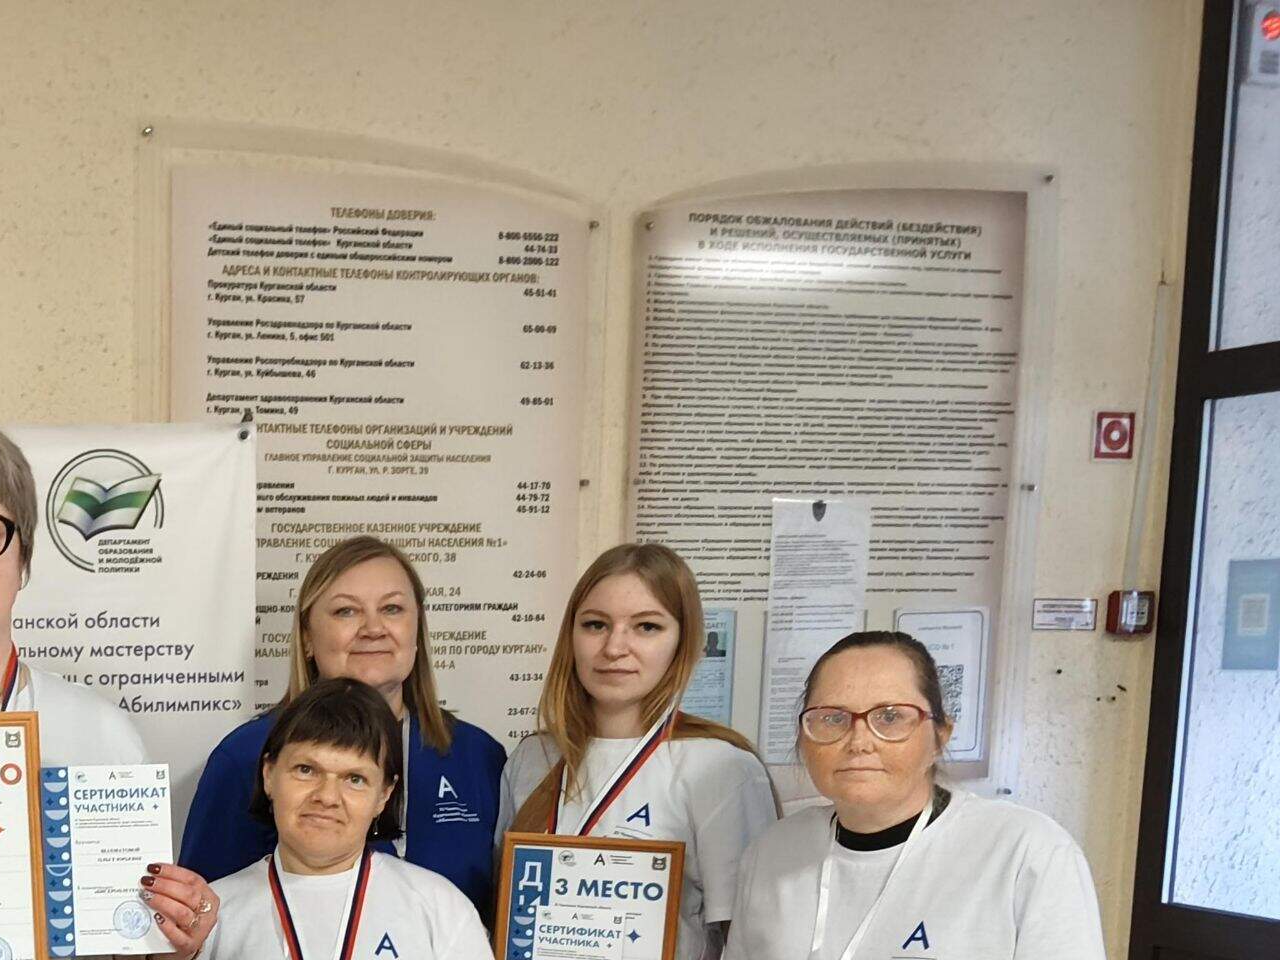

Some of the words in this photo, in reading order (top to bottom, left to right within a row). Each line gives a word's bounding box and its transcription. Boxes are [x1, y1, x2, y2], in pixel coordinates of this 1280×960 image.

[331, 207, 385, 218] ТЕЛЕФОНЫ
[387, 210, 436, 220] ДОВЕРИЯ:
[689, 213, 743, 224] ПОРЯДОК
[747, 217, 832, 227] ОБЖАЛОВАНИЯ
[836, 218, 893, 230] ДЕЙСТВИЙ
[897, 221, 982, 237] (БЕЗДЕЙСТВИЯ)
[710, 228, 718, 236] И
[721, 227, 779, 239] РЕШЕНИЙ,
[782, 230, 889, 244] ОСУЩЕСТВЛЯЕМЫХ
[892, 234, 961, 248] (ПРИНЯТЫХ)
[336, 239, 379, 248] Курганской
[382, 241, 413, 249] области
[208, 247, 240, 256] Детский
[242, 249, 274, 258] телефон
[709, 242, 737, 250] ХОДЕ
[742, 242, 818, 253] ИСПОЛНЕНИЯ
[820, 245, 927, 258] ГОСУДАРСТВЕННОЙ
[930, 250, 971, 260] УСЛУГИ
[222, 264, 260, 275] АДРЕСА
[263, 265, 270, 275] И
[272, 266, 338, 278] КОНТАКТНЫЕ
[340, 268, 393, 279] ТЕЛЕФОНЫ
[396, 271, 490, 282] КОНТРОЛИРУЮЩИХ
[492, 273, 540, 283] ОРГАНОВ:
[208, 279, 257, 290] Прокуратура
[260, 282, 303, 291] Курганской
[306, 283, 337, 291] области
[208, 318, 253, 327] Управление
[336, 322, 379, 330] Курганской
[381, 322, 412, 330] области
[299, 333, 318, 342] офис
[208, 356, 253, 364] Управление
[255, 357, 326, 366] Роспотребнадзора
[340, 359, 382, 367] Курганской
[384, 359, 414, 367] области
[206, 393, 258, 402] Департамент
[329, 395, 372, 404] Курганской
[310, 424, 362, 434] ТЕЛЕФОНЫ
[366, 423, 437, 435] ОРГАНИЗАЦИЙ
[439, 426, 446, 435] И
[449, 424, 513, 436] УЧРЕЖДЕНИЙ
[327, 438, 394, 450] СОЦИАЛЬНОЙ
[397, 439, 432, 450] СФЕРЫ
[265, 454, 300, 462] ГЛАВНОЕ
[302, 454, 352, 462] УПРАВЛЕНИЕ
[354, 453, 408, 463] СОЦИАЛЬНОЙ
[410, 455, 444, 463] ЗАЩИТЫ
[446, 455, 491, 463] НАСЕЛЕНИЯ
[275, 494, 330, 502] обслуживания
[367, 493, 389, 502] людей
[265, 506, 305, 515] ветеранов
[272, 523, 365, 533] ГОСУДАРСТВЕННОЕ
[367, 523, 416, 532] КАЗЕННОЕ
[419, 523, 482, 533] УЧРЕЖДЕНИЕ
[429, 538, 484, 547] НАСЕЛЕНИЯ
[106, 556, 162, 564] МОЛОДЁЖНОЙ
[444, 553, 456, 562] 38
[449, 587, 461, 596] 24
[13, 611, 78, 630] анской
[85, 611, 160, 629] области
[16, 644, 84, 662] льному
[90, 644, 194, 661] мастерству
[449, 646, 461, 655] ПО
[465, 646, 500, 655] ГОРОДУ
[84, 673, 93, 686] с
[99, 671, 244, 690] ограниченными
[119, 696, 242, 714] Абилимпикс»
[74, 787, 167, 800] СЕРТИФИКАТ
[74, 803, 144, 813] УЧАСТНИКА
[555, 878, 568, 896] 3
[577, 879, 663, 901] МЕСТО
[539, 924, 622, 940] СЕРТИФИКАТ
[538, 937, 600, 949] УЧАСТНИКА
